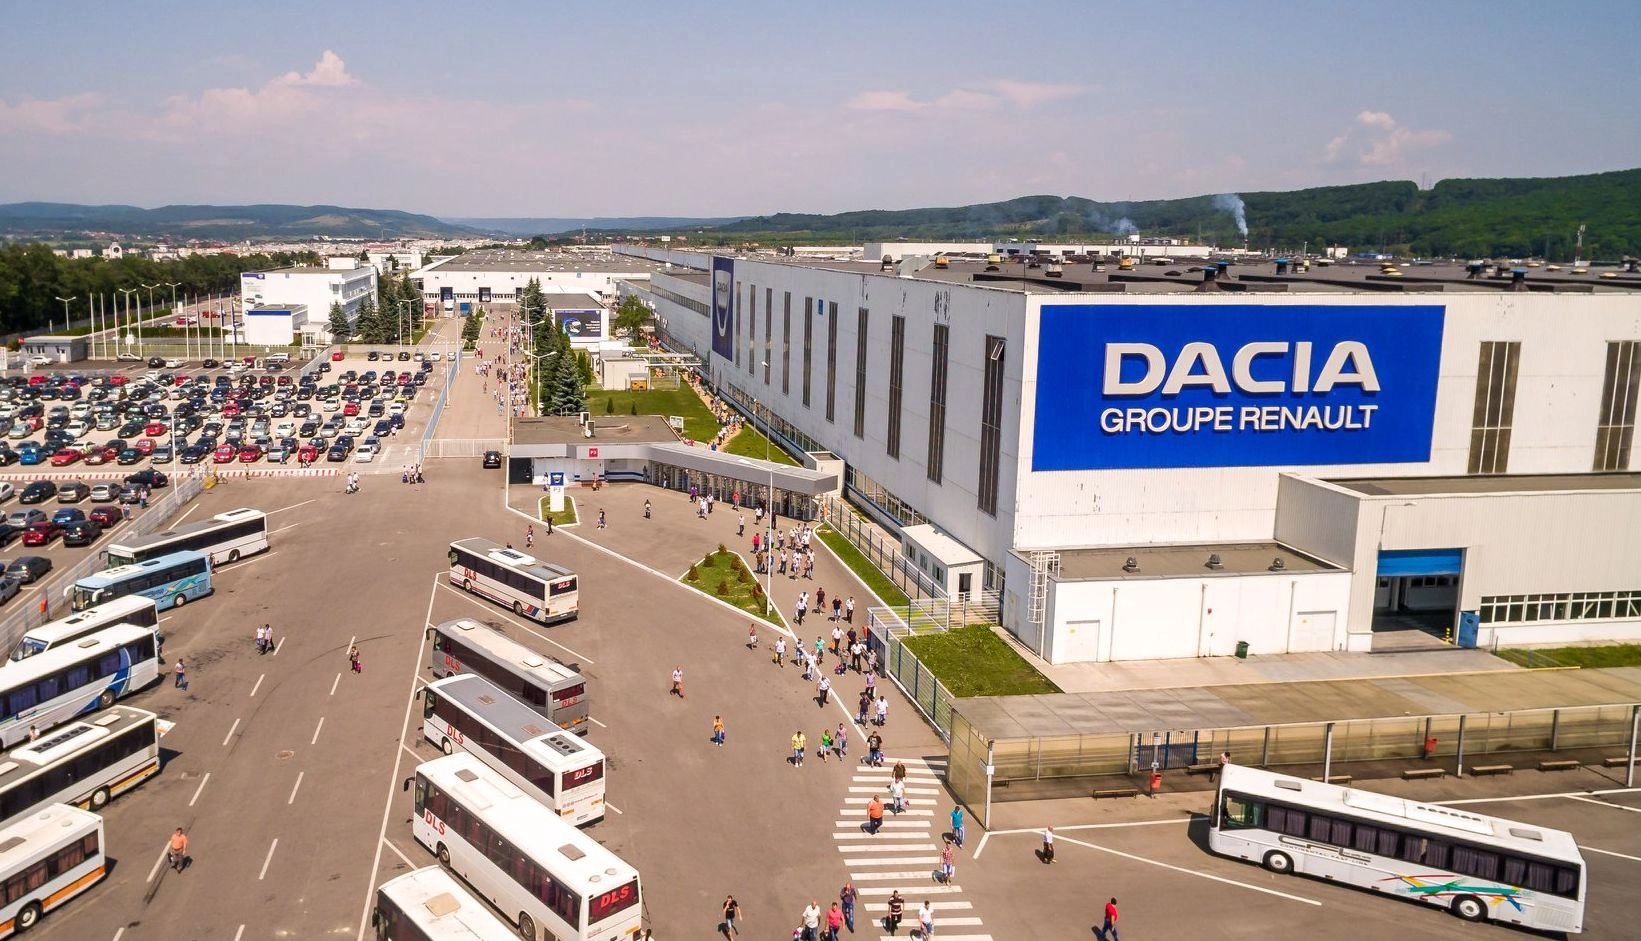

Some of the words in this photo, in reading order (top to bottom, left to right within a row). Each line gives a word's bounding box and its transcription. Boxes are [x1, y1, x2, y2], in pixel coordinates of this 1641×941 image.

[1103, 341, 1381, 395] DACIA
[1100, 406, 1234, 433] GROUPE
[1239, 405, 1379, 431] RENAULT
[464, 568, 477, 580] DLS
[557, 581, 571, 589] DLS
[446, 656, 460, 671] DLS
[561, 696, 577, 707] DLS
[447, 724, 464, 744] DLS
[574, 767, 593, 780] DLS
[426, 811, 445, 835] DLS
[600, 885, 630, 908] DLS
